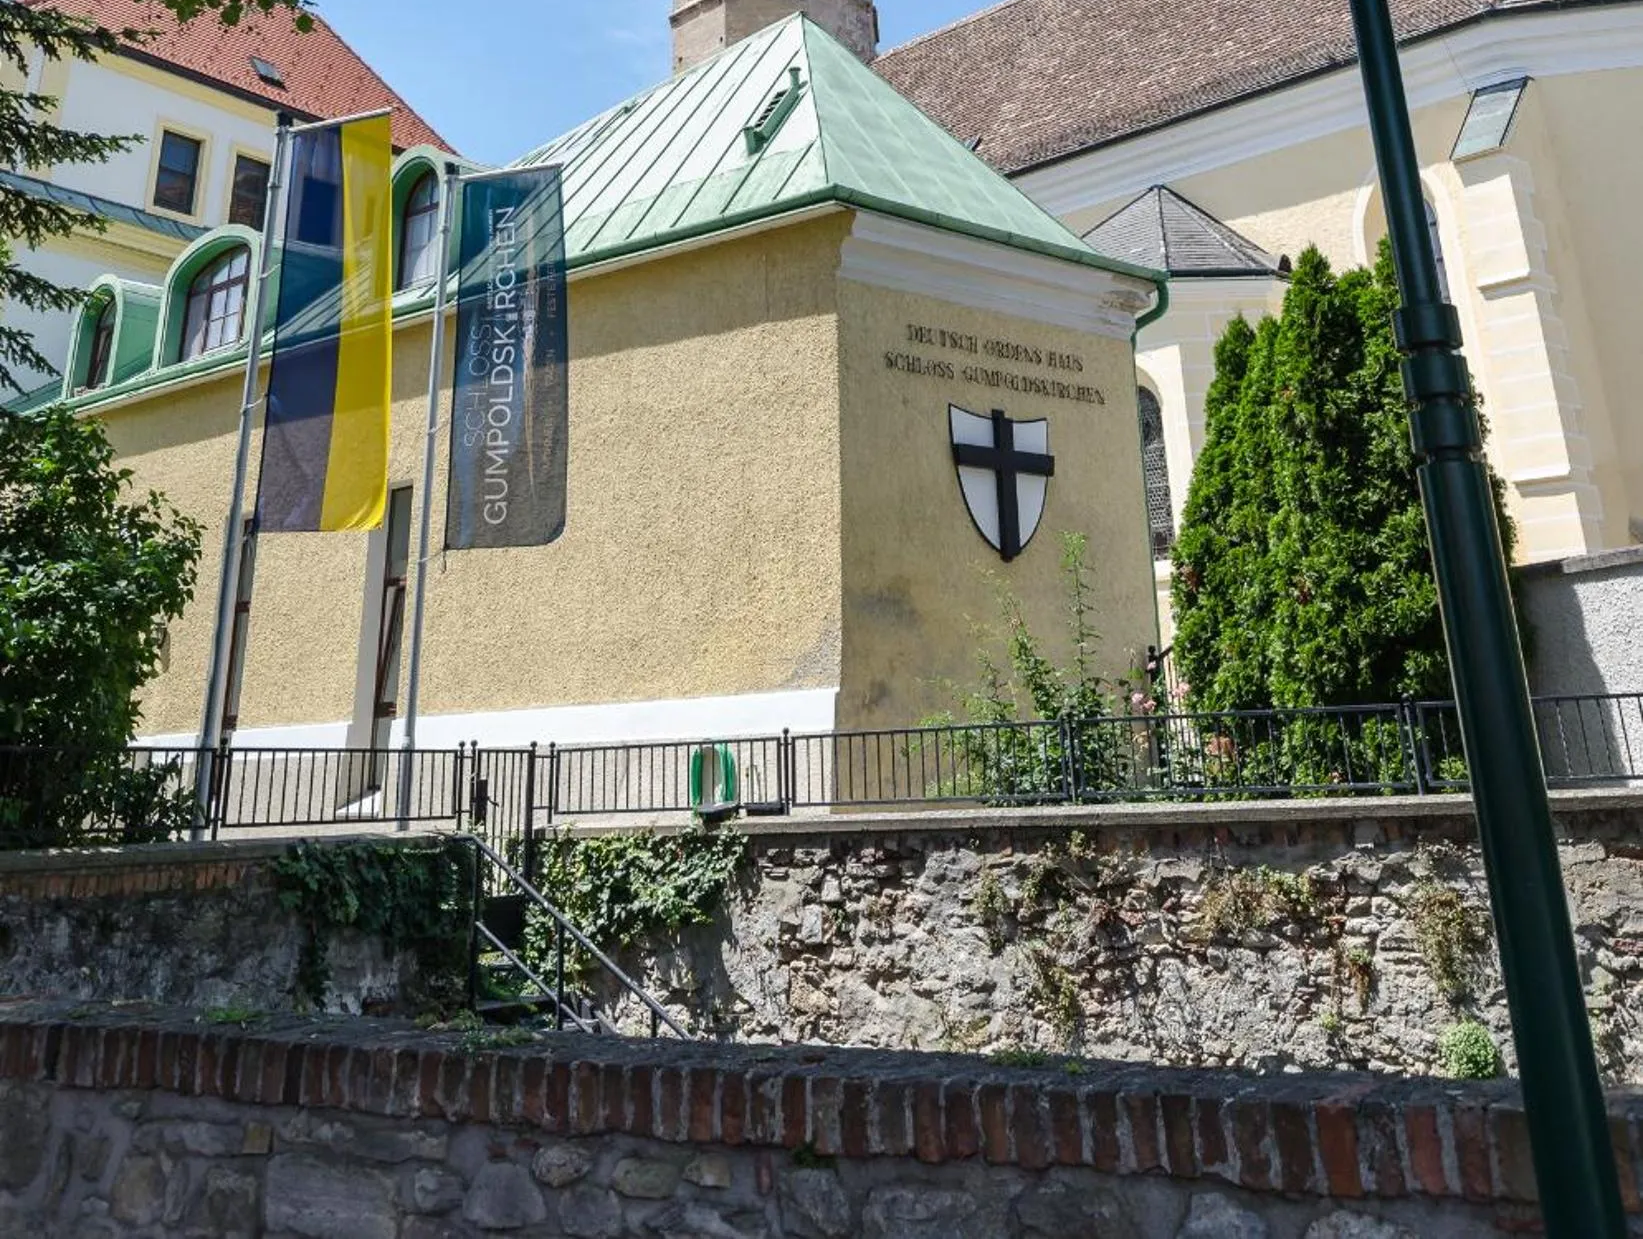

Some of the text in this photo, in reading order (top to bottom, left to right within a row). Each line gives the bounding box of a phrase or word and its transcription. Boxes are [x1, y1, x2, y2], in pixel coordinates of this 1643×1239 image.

[464, 324, 492, 448] SCHLOSS
[484, 206, 518, 525] GUMPOLDSKIRCHEN
[884, 351, 1105, 405] SCHLOSS GUMPOLDSKIRCHEN
[906, 323, 1083, 372] DEUTSCH ORDENS HAUS
